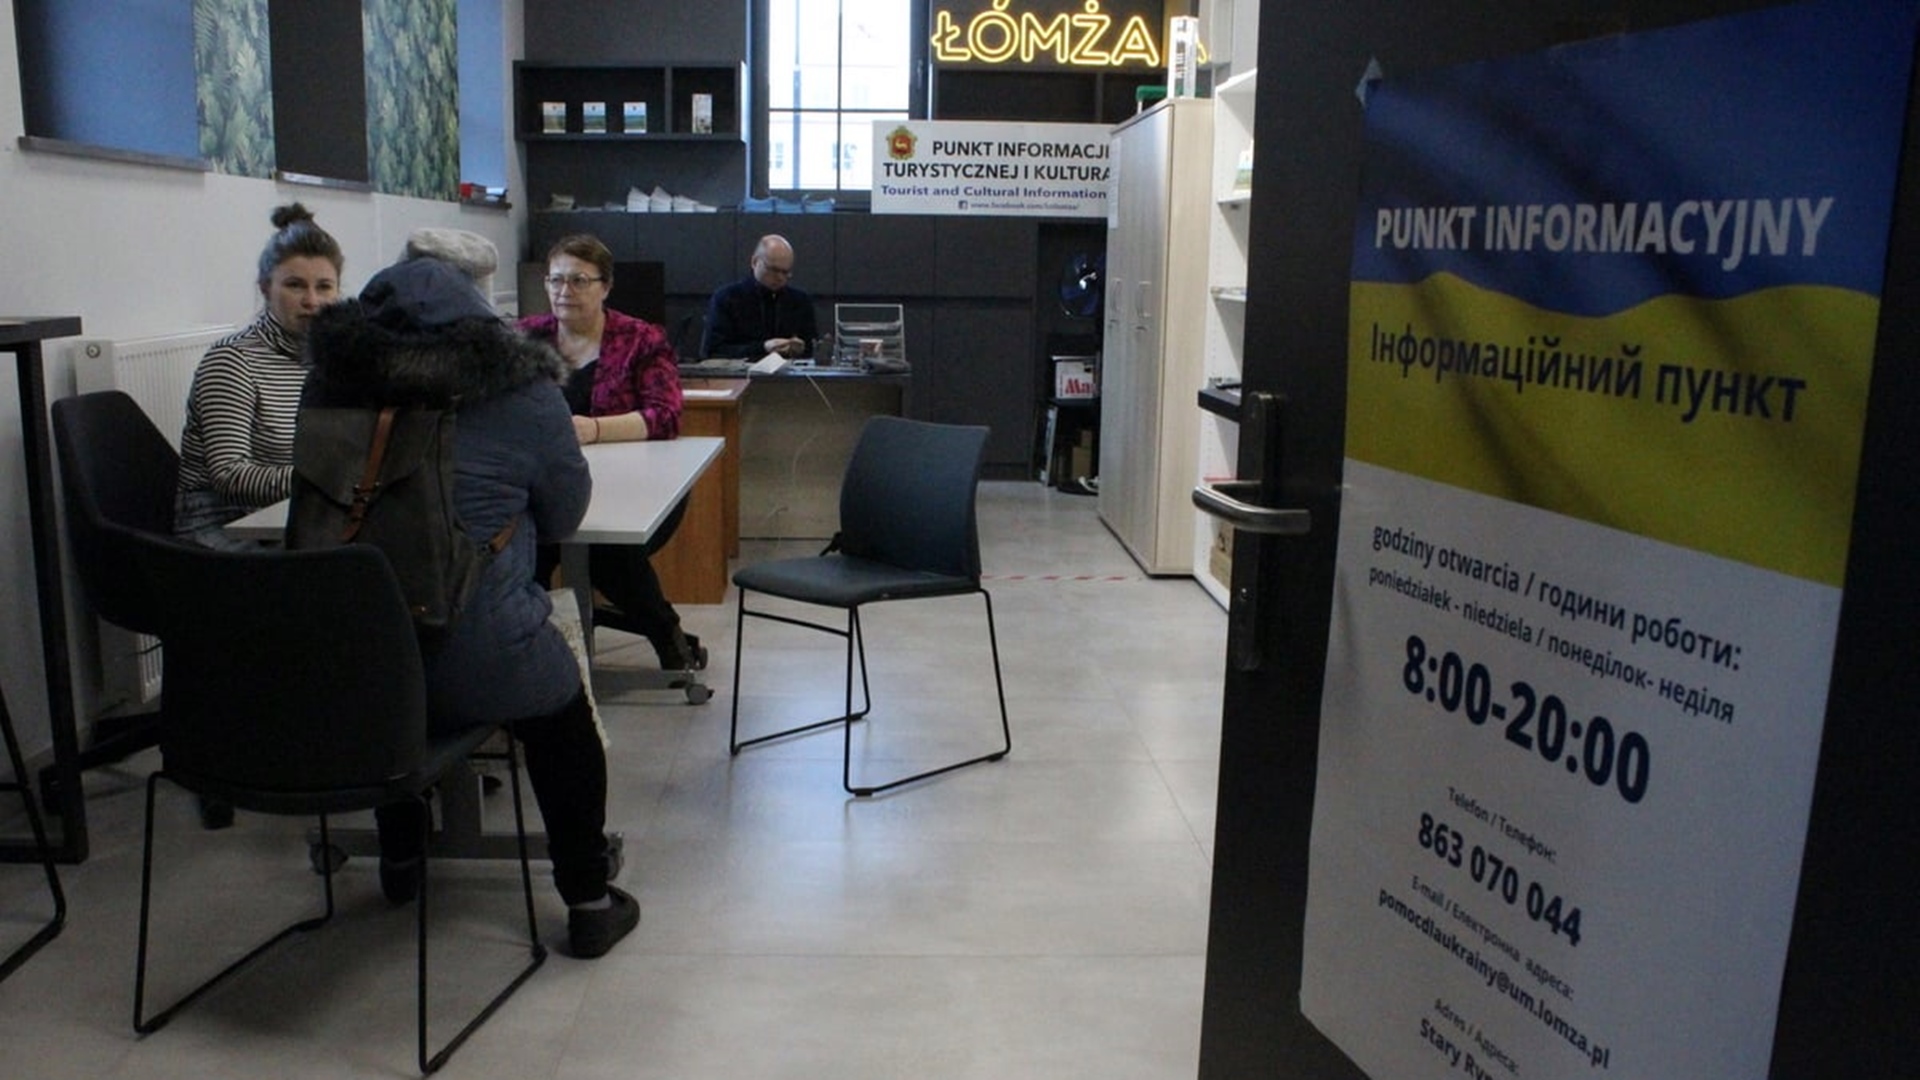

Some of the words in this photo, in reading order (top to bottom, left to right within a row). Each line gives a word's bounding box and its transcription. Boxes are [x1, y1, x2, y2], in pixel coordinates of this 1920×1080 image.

[931, 0, 1160, 67] ŁÓMŻA
[883, 162, 1019, 180] TURYSTYCZNEJ
[1024, 166, 1029, 180] I
[932, 140, 994, 156] PUNKT
[881, 185, 929, 196] Tourist
[932, 185, 959, 196] and
[963, 186, 1019, 198] Cultural
[1023, 187, 1107, 200] Information
[1375, 205, 1476, 251] PUNKT
[1484, 197, 1833, 272] INFORMACYJNY
[1371, 322, 1641, 401] Інформаційний
[1655, 363, 1806, 424] пункт
[1373, 525, 1435, 569] godziny
[1438, 548, 1520, 592] otwarcia
[1525, 572, 1536, 597] /
[1539, 581, 1626, 631] години
[1631, 613, 1742, 671] роботи:
[1369, 567, 1452, 613] poniedziałek
[1463, 600, 1532, 644] niedziela
[1536, 627, 1545, 647] /
[1659, 678, 1735, 724] неділя
[1403, 635, 1650, 804] 8:00-20:00
[1448, 786, 1489, 823] Telefon
[1418, 812, 1463, 868] 863
[1470, 845, 1519, 905] 070
[1526, 881, 1581, 947] 044
[1379, 889, 1610, 1069] pomocdlaukrainy@um.lomza.pl
[1420, 1018, 1461, 1067] Stary
